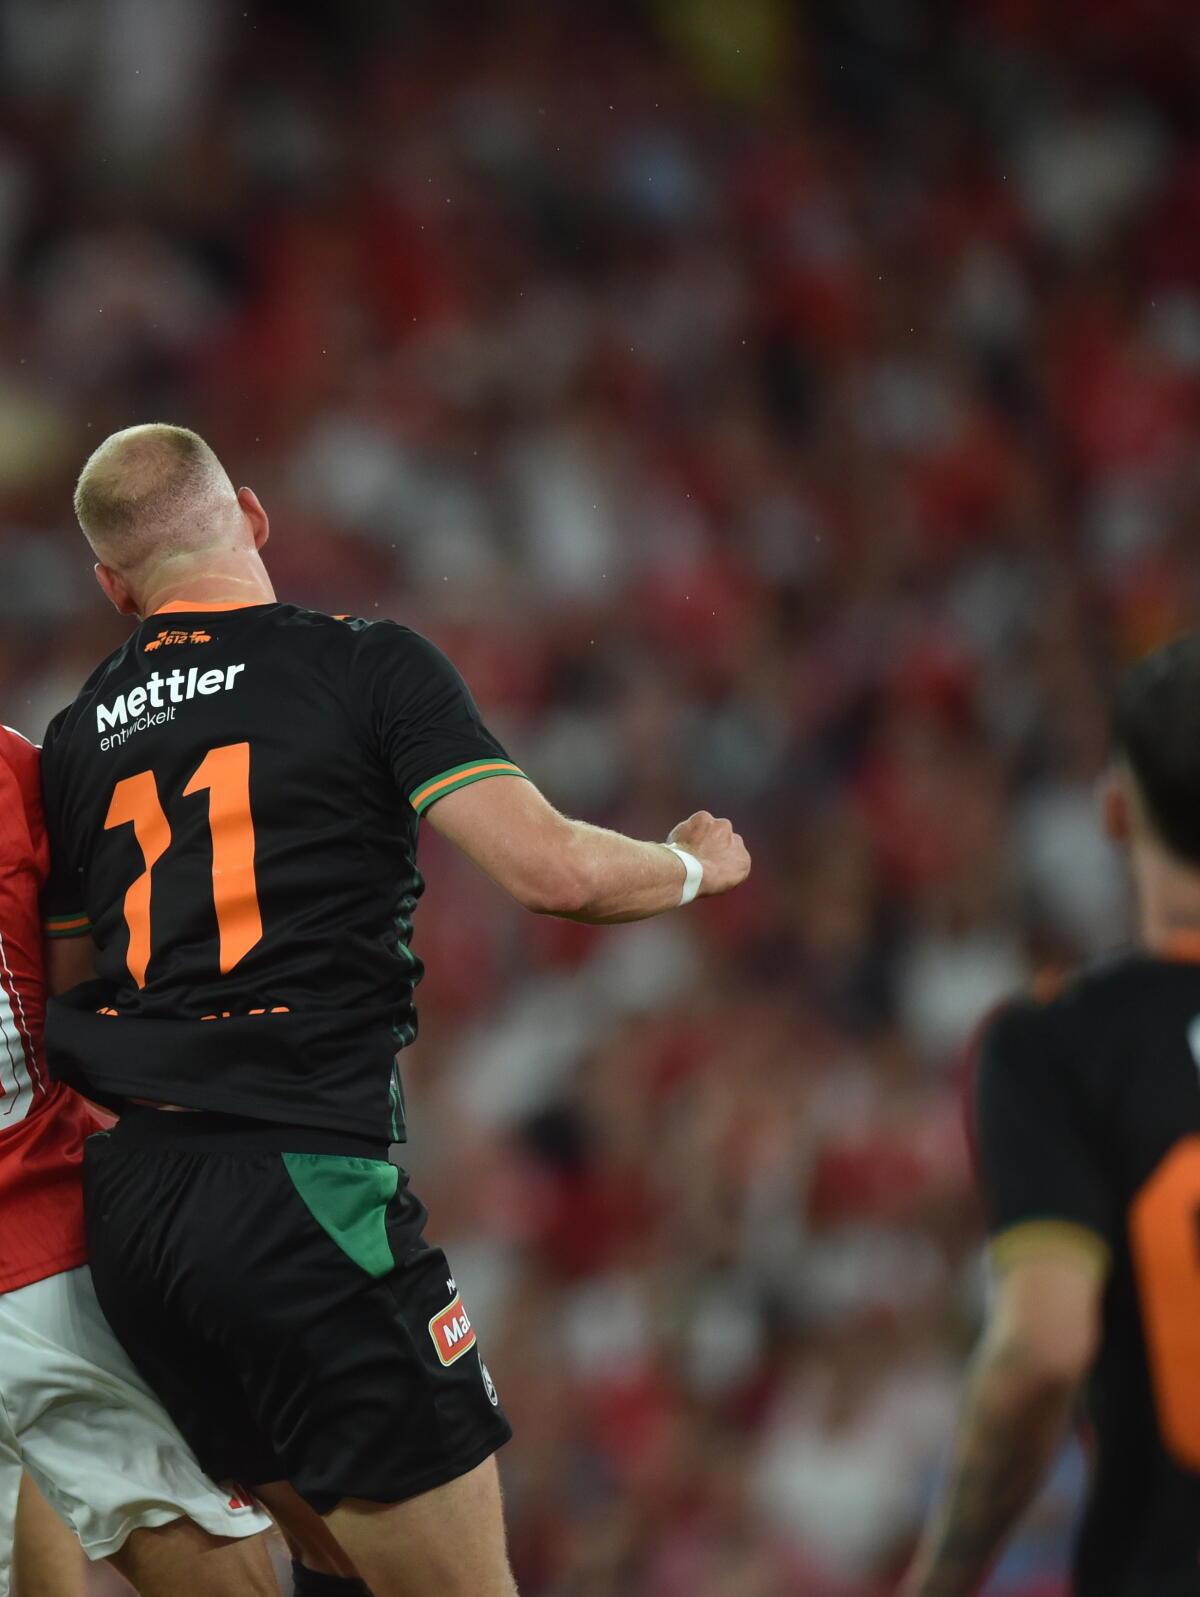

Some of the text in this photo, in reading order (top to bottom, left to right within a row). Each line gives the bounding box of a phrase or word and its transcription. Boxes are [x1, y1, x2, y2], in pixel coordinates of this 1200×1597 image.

[96, 663, 245, 733] Mettler
[99, 705, 177, 752] entwickelt
[104, 741, 263, 990] 11
